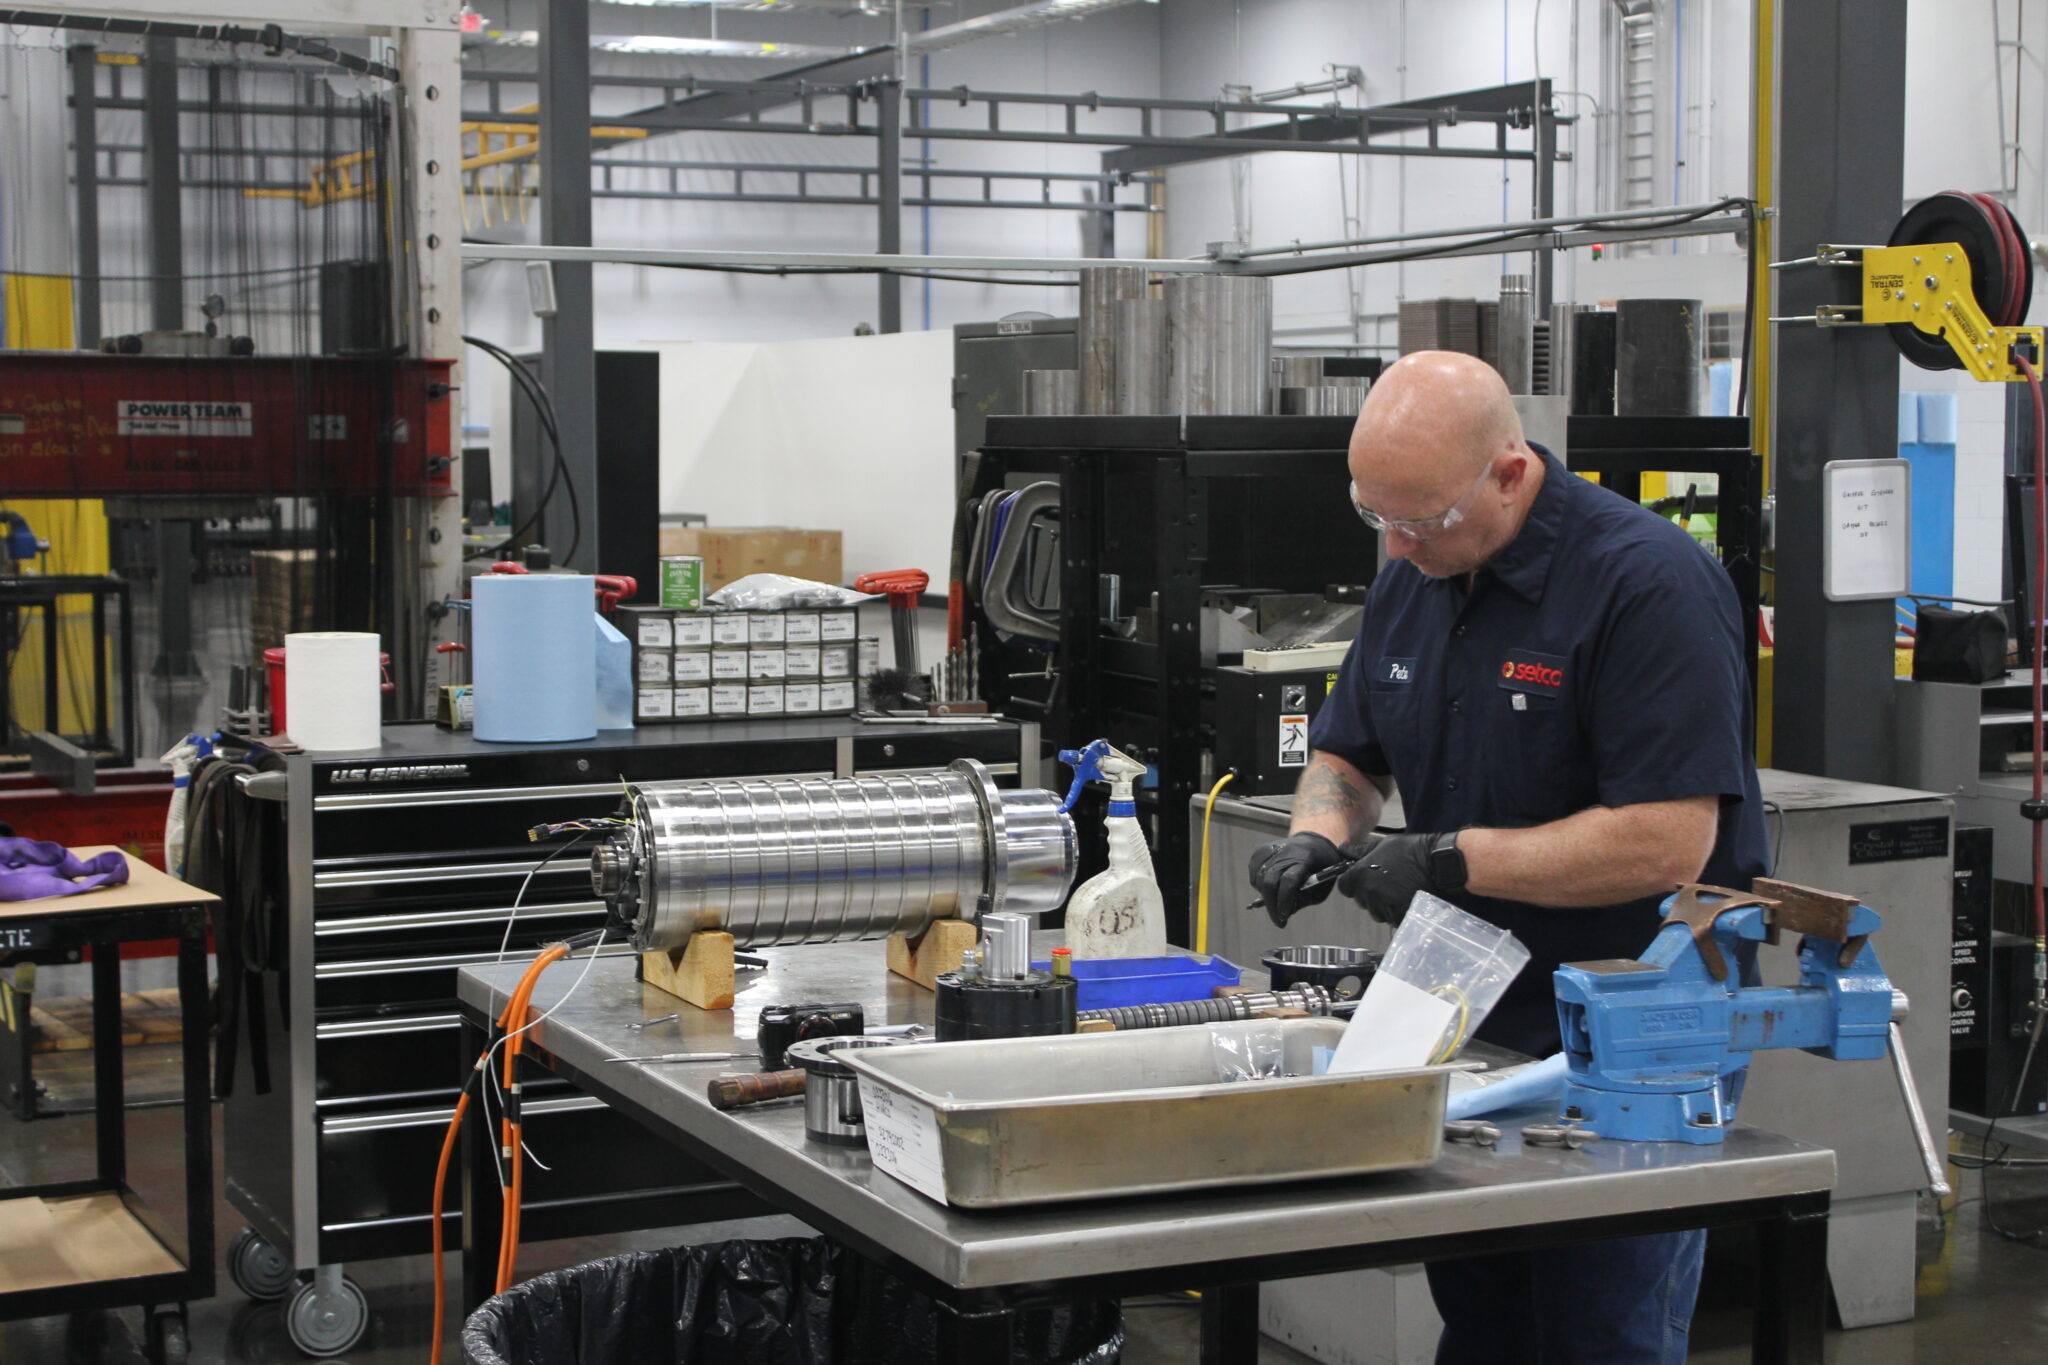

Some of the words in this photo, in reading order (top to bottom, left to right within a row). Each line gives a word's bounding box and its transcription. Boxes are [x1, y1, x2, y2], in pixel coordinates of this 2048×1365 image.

[1870, 280, 1904, 288] CENTRAL
[127, 403, 191, 417] POWER
[195, 404, 243, 417] TEAM
[1389, 663, 1409, 680] Pete
[369, 764, 471, 782] GENERAL
[1853, 840, 1895, 852] Crystal
[1951, 1026, 1970, 1034] VALVE
